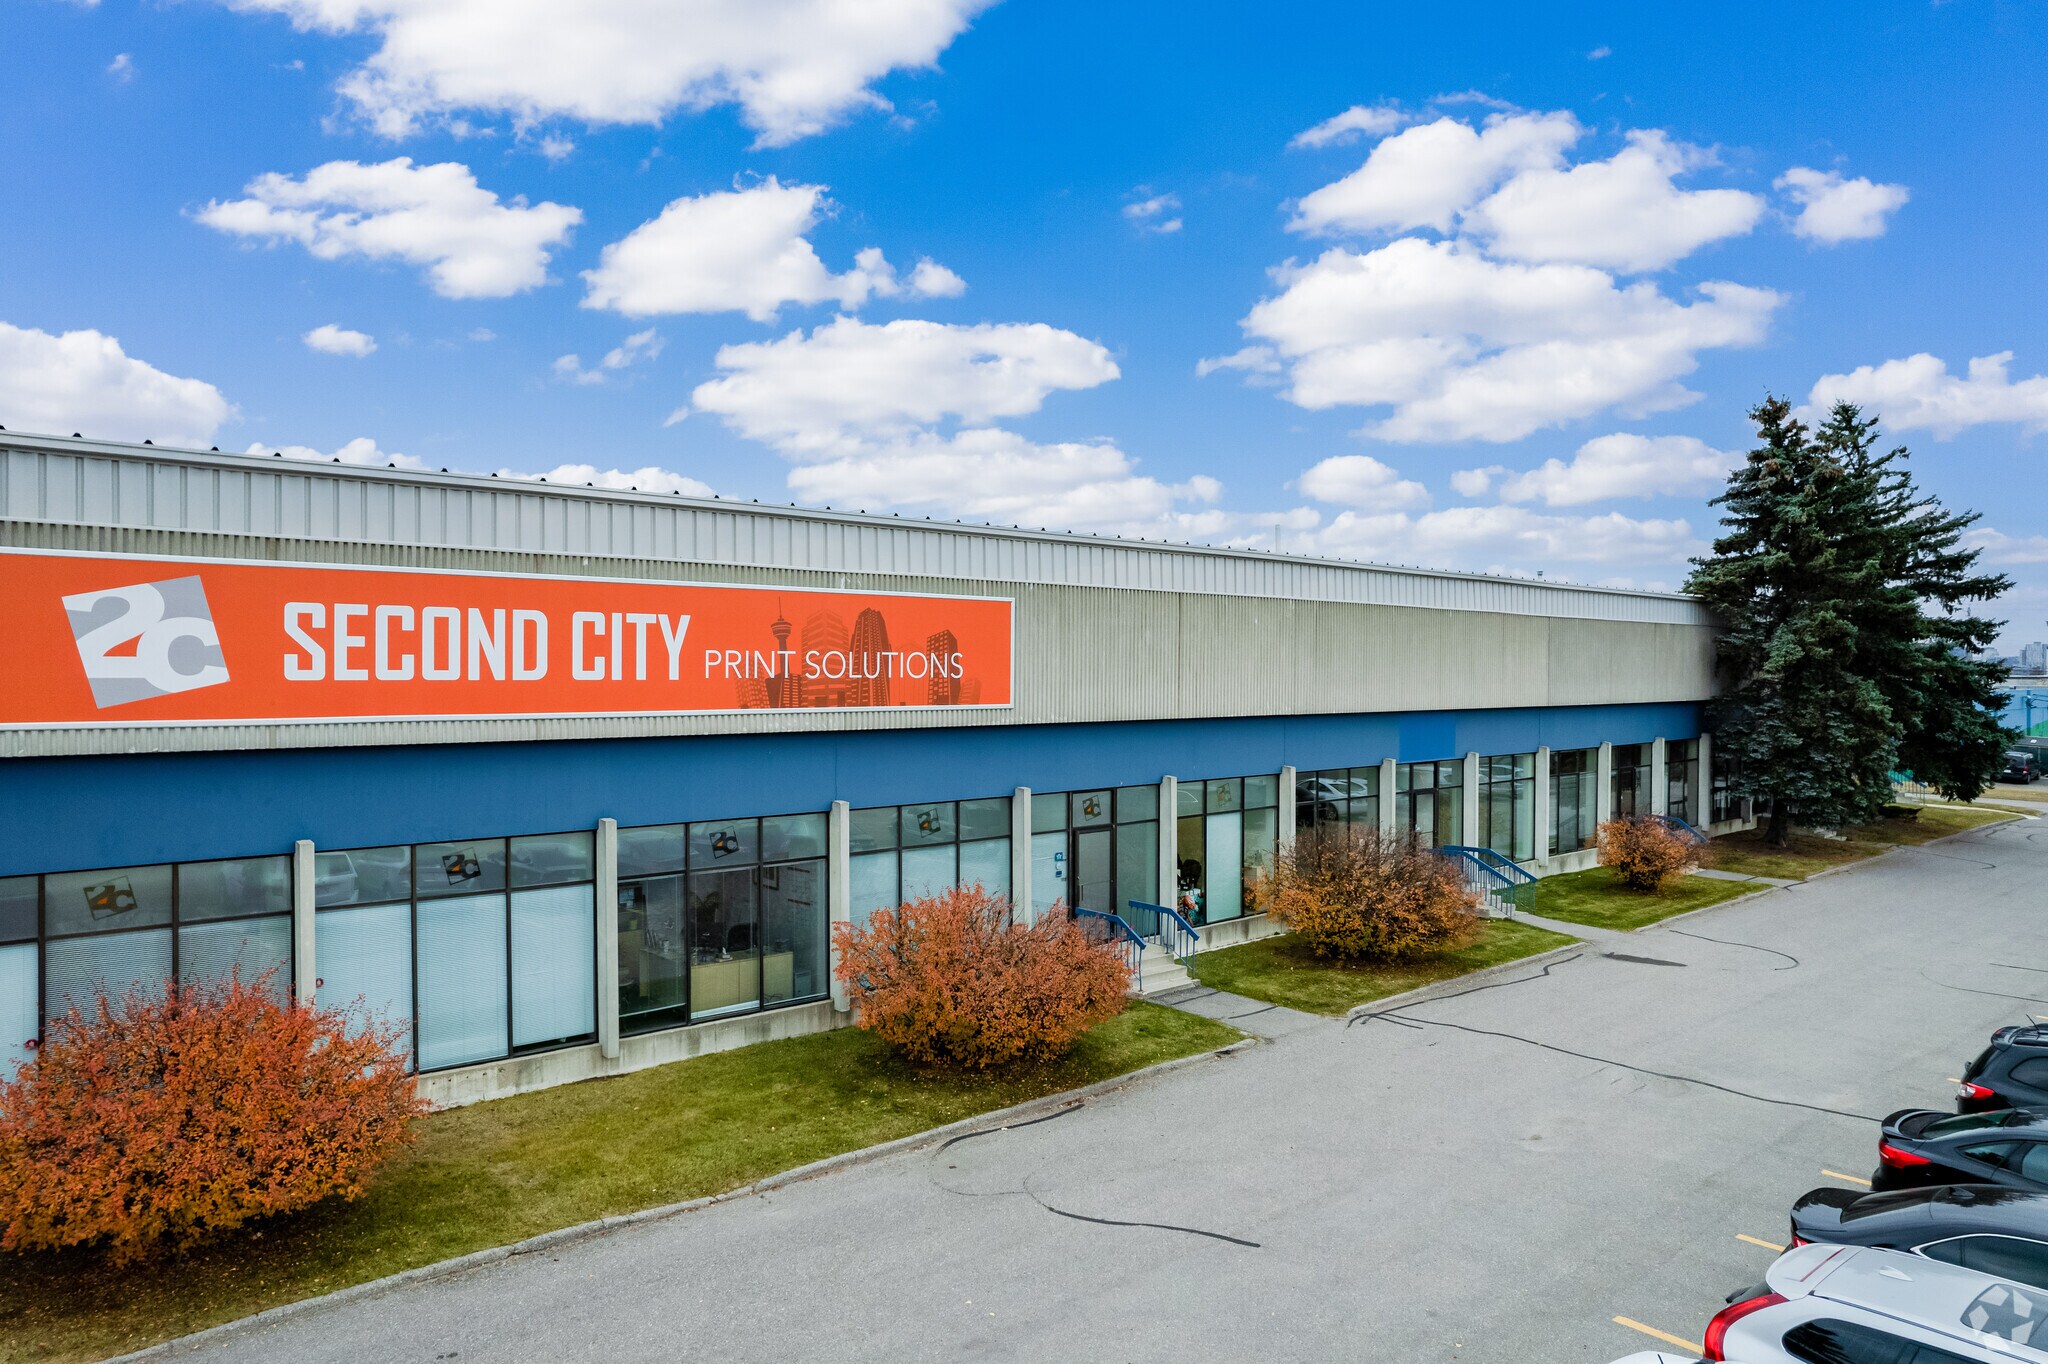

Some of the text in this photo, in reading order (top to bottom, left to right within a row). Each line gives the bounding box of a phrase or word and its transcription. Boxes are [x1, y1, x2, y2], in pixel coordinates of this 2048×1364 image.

[284, 602, 964, 681] SECOND CITY PRINT SOLUTIONS
